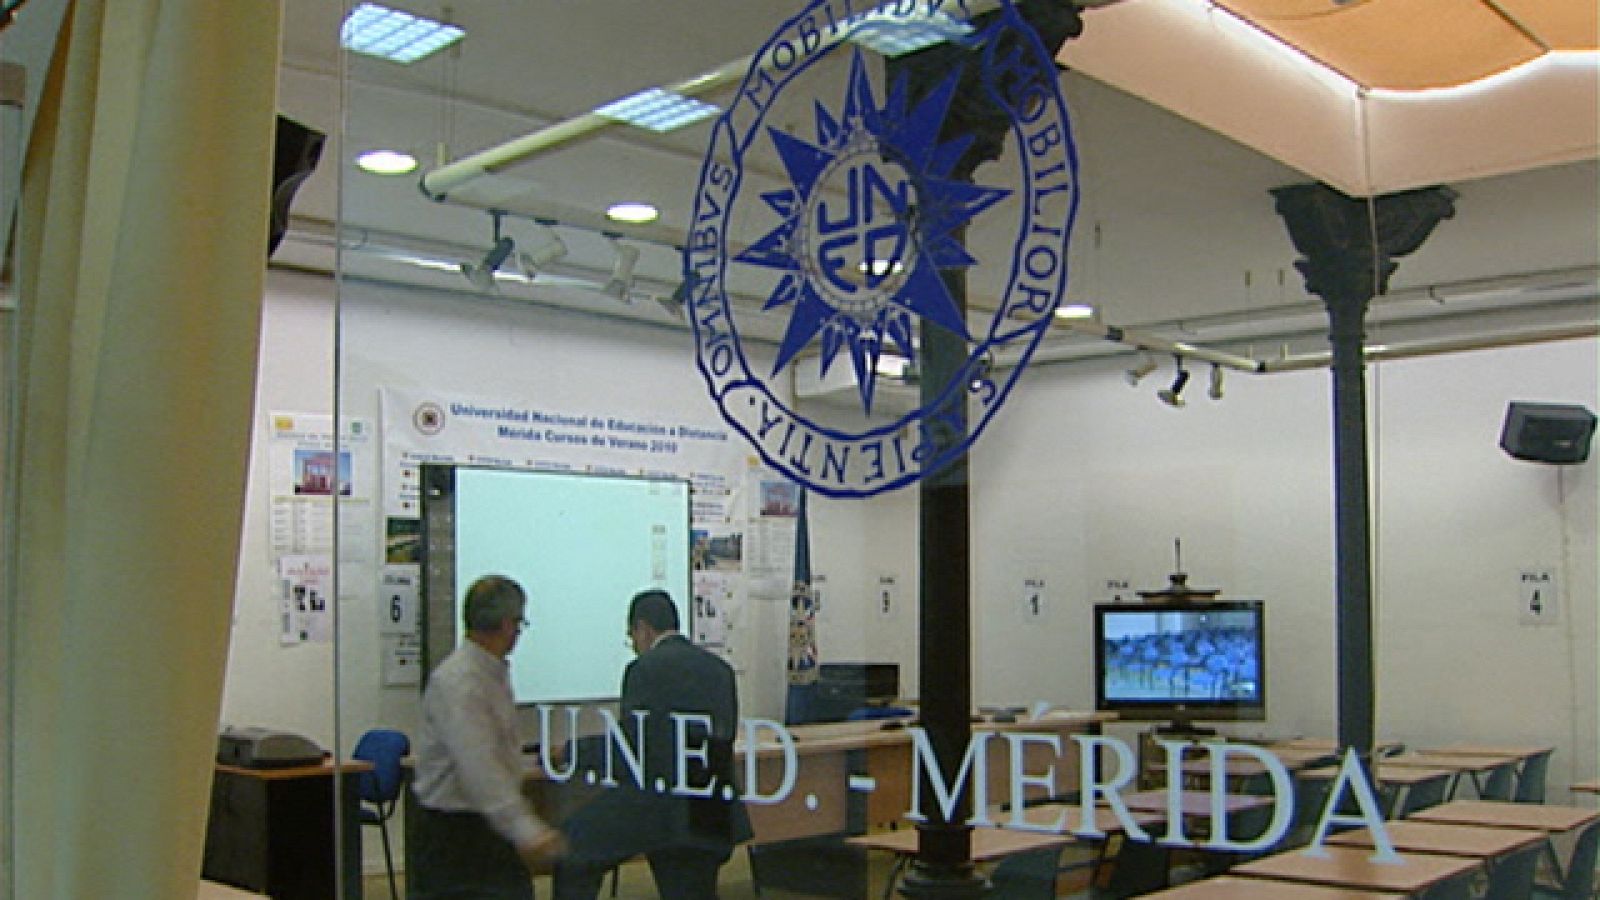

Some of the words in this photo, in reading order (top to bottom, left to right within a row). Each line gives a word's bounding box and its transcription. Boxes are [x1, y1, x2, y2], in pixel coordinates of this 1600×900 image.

[450, 403, 528, 421] Universidad
[532, 409, 587, 427] Nacional
[590, 416, 605, 428] de
[670, 426, 676, 436] a
[679, 425, 728, 441] Distancia
[544, 429, 587, 443] Cursos
[591, 435, 605, 445] de
[608, 437, 648, 450] Verano
[390, 594, 402, 622] 6
[1030, 594, 1039, 615] 1
[536, 703, 818, 810] U.N.E.D.
[903, 703, 1396, 866] MÉRIDA
